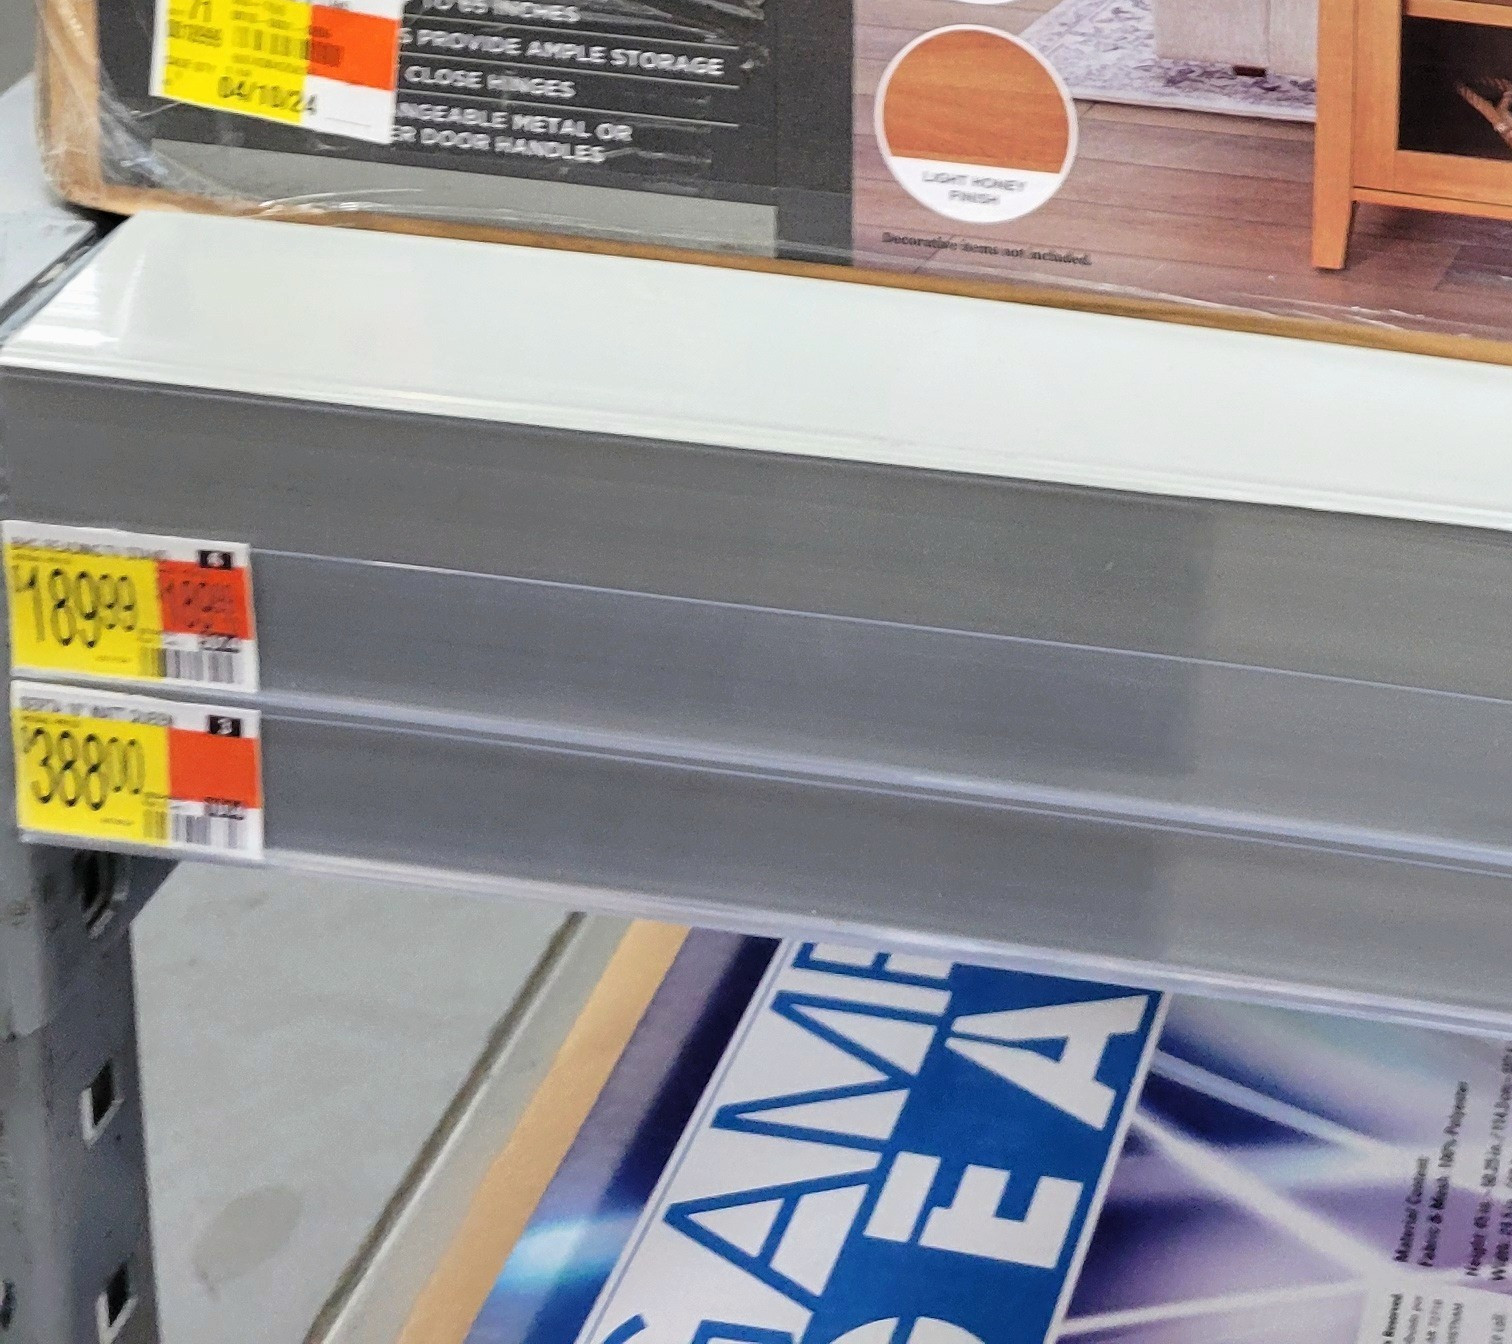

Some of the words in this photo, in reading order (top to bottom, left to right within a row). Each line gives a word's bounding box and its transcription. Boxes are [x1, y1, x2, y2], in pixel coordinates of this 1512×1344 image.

[492, 0, 582, 23] INCHES
[416, 28, 522, 55] PROVIDE
[525, 40, 607, 62] AMPLE
[610, 49, 725, 76] STORAGE
[404, 65, 483, 89] CLOSE
[486, 73, 577, 98] HINGES
[511, 113, 593, 139] METAL
[595, 122, 633, 142] OR
[420, 127, 490, 150] DOOR
[494, 136, 605, 163] HANDLES
[922, 170, 967, 189] LIGHT
[972, 174, 1025, 192] HONEY
[949, 189, 1001, 207] FINISH
[882, 231, 957, 250] Decorative
[961, 239, 999, 255] items
[1002, 248, 1025, 258] not
[1029, 250, 1092, 266] included.
